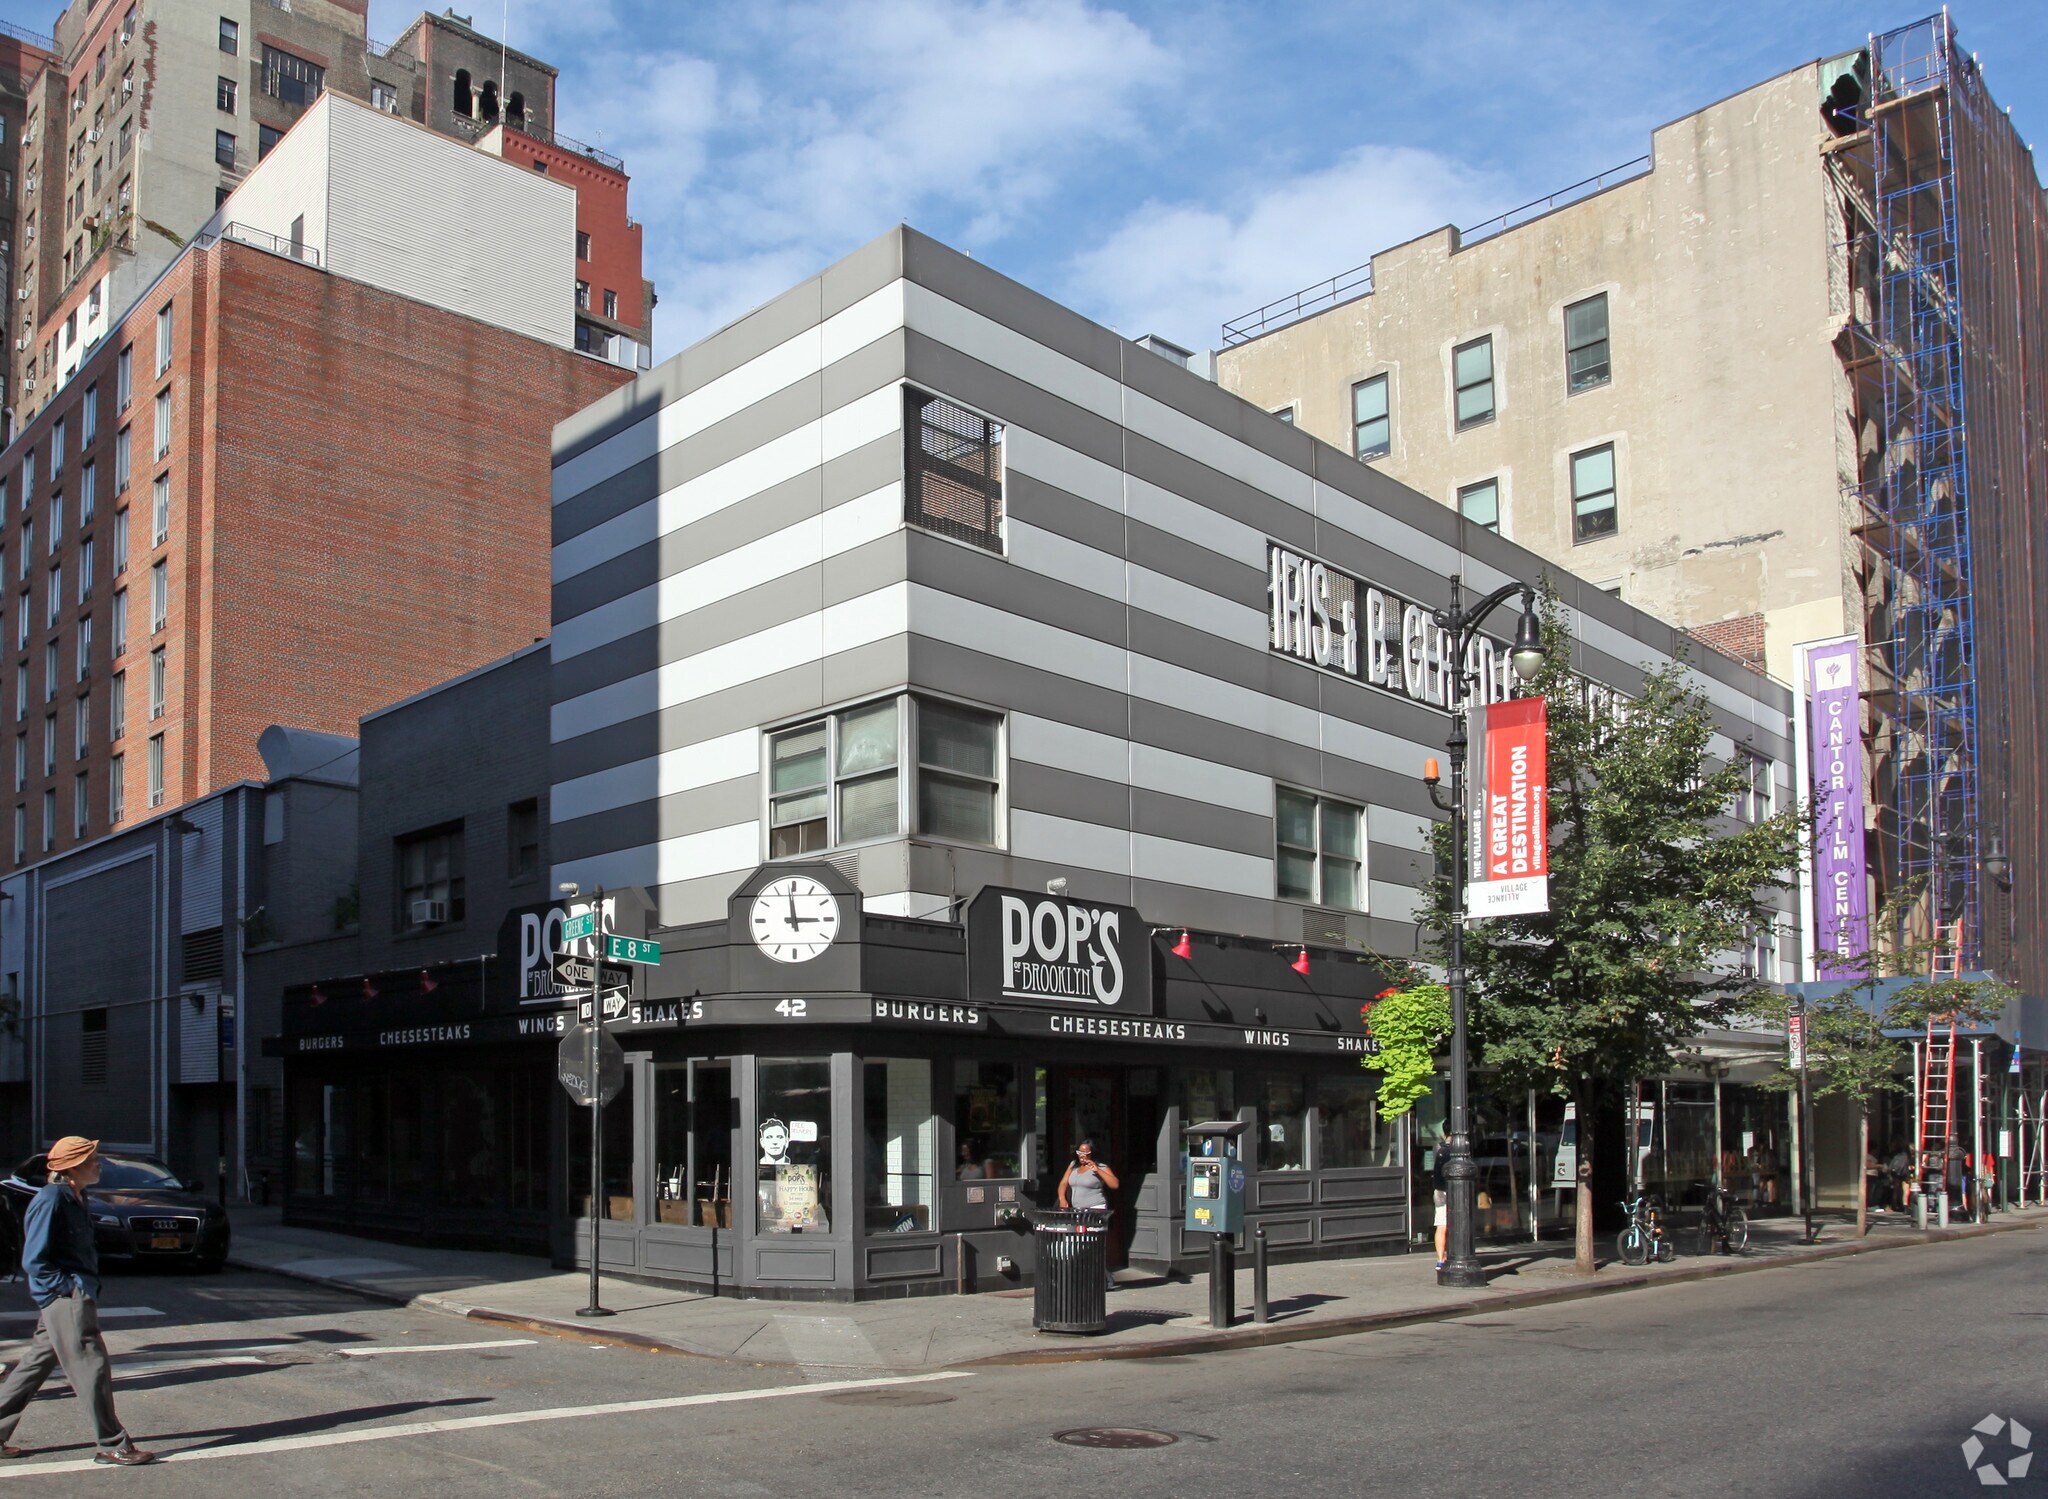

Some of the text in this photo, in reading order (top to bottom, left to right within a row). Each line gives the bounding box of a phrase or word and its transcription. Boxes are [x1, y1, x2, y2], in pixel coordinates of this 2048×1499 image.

[1272, 546, 1330, 667] IRIS
[1342, 600, 1358, 676] &
[1828, 701, 1845, 790] CANTOR
[1511, 745, 1528, 874] DESTINATION
[1532, 785, 1542, 870] villagealliance.org
[1473, 820, 1482, 858] VILLAGE
[1492, 794, 1508, 875] A GREAT
[1833, 801, 1848, 861] FILM
[1473, 861, 1482, 879] THE
[1500, 882, 1528, 893] VILLAGE
[565, 916, 584, 939] GREENE
[612, 938, 651, 959] E 8 ST
[1001, 895, 1124, 1005] POP'S
[1013, 961, 1021, 973] OF
[565, 965, 623, 985] ONE WAY
[1022, 962, 1092, 996] BROOKLYN
[605, 998, 621, 1012] WAY
[774, 998, 807, 1018] 42
[875, 1000, 979, 1024] BURGERS
[1050, 1015, 1186, 1040] CHEESESTEAKS
[1244, 1030, 1290, 1046] WINGS
[299, 1001, 703, 1050] BURGERS CHEESESTEAKS WINGS SHAKES
